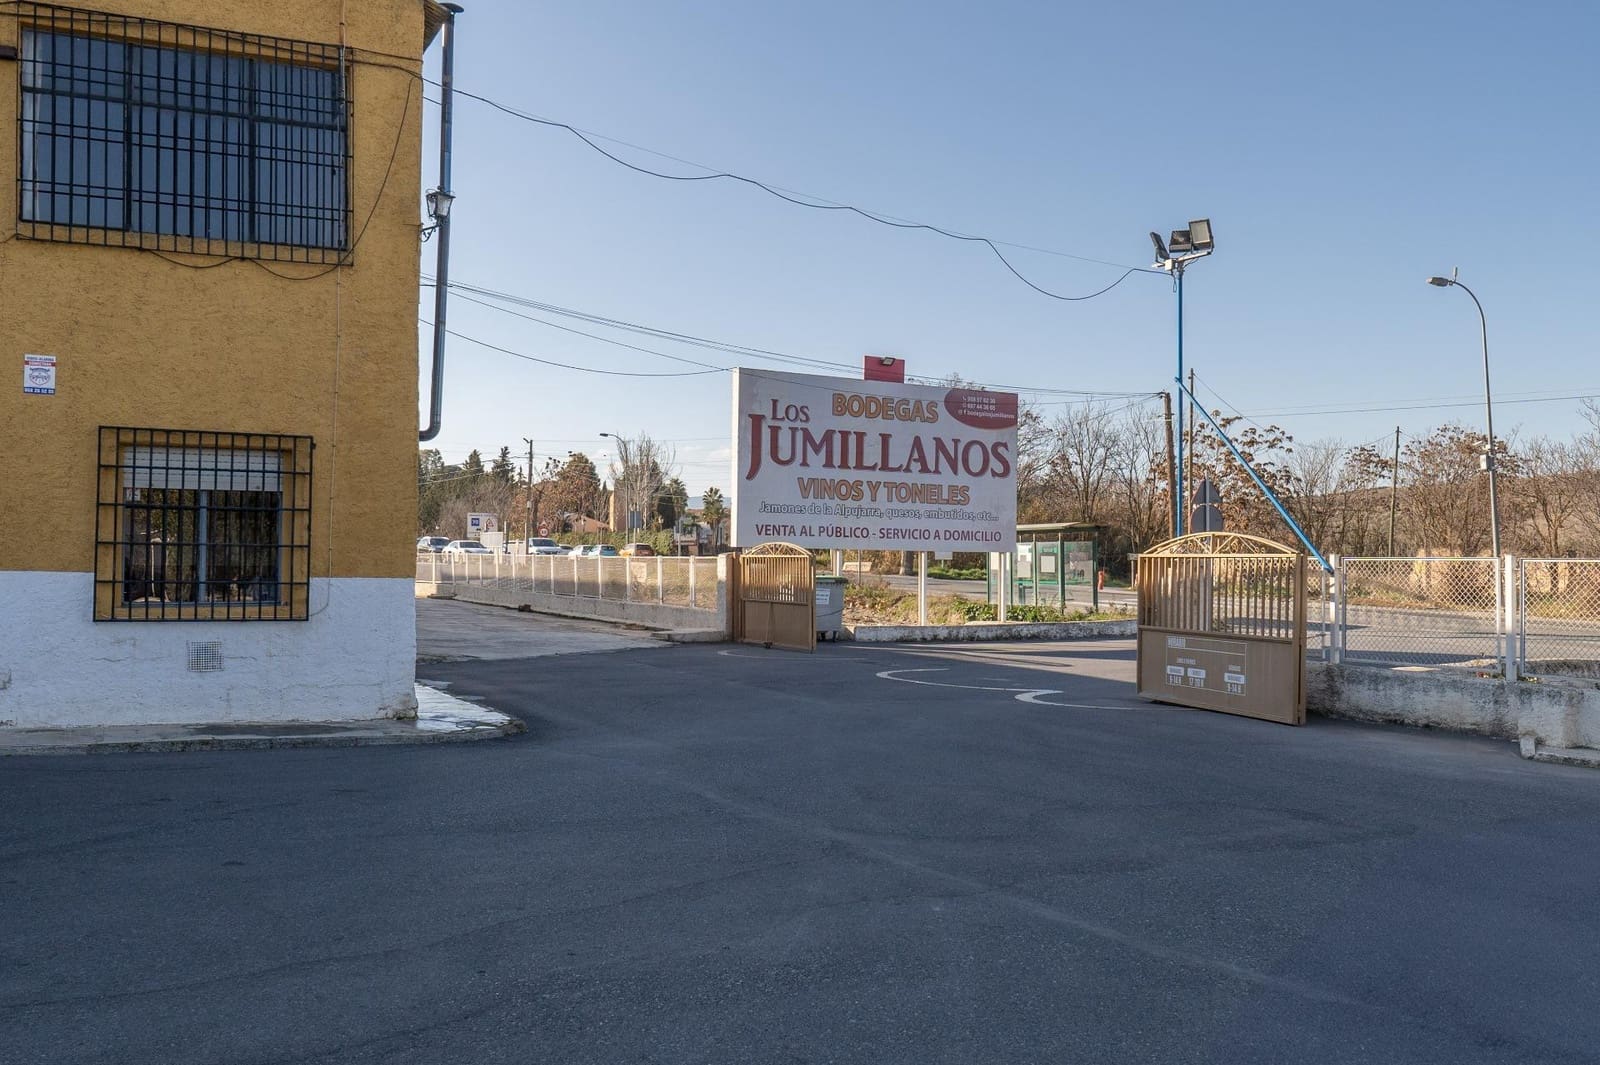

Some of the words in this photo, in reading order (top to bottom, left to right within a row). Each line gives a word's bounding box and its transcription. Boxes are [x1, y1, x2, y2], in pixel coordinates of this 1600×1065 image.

[770, 399, 810, 423] LOS
[832, 393, 939, 423] BODEGAS
[746, 413, 1011, 480] JUMILLANOS
[797, 477, 864, 501] VINOS
[867, 481, 881, 502] Y
[883, 482, 970, 506] TONELES
[759, 501, 807, 515] Jamones
[807, 503, 821, 515] de
[823, 503, 833, 516] la
[833, 504, 884, 520] Alpujarra,
[886, 508, 922, 521] quesos,
[924, 508, 976, 522] embutidos,
[755, 524, 796, 537] VENTA
[799, 525, 815, 537] AL
[818, 524, 870, 539] PÚBLICO
[879, 528, 931, 540] SERVICIO
[933, 530, 941, 541] A
[943, 530, 1002, 542] DOMICILIO
